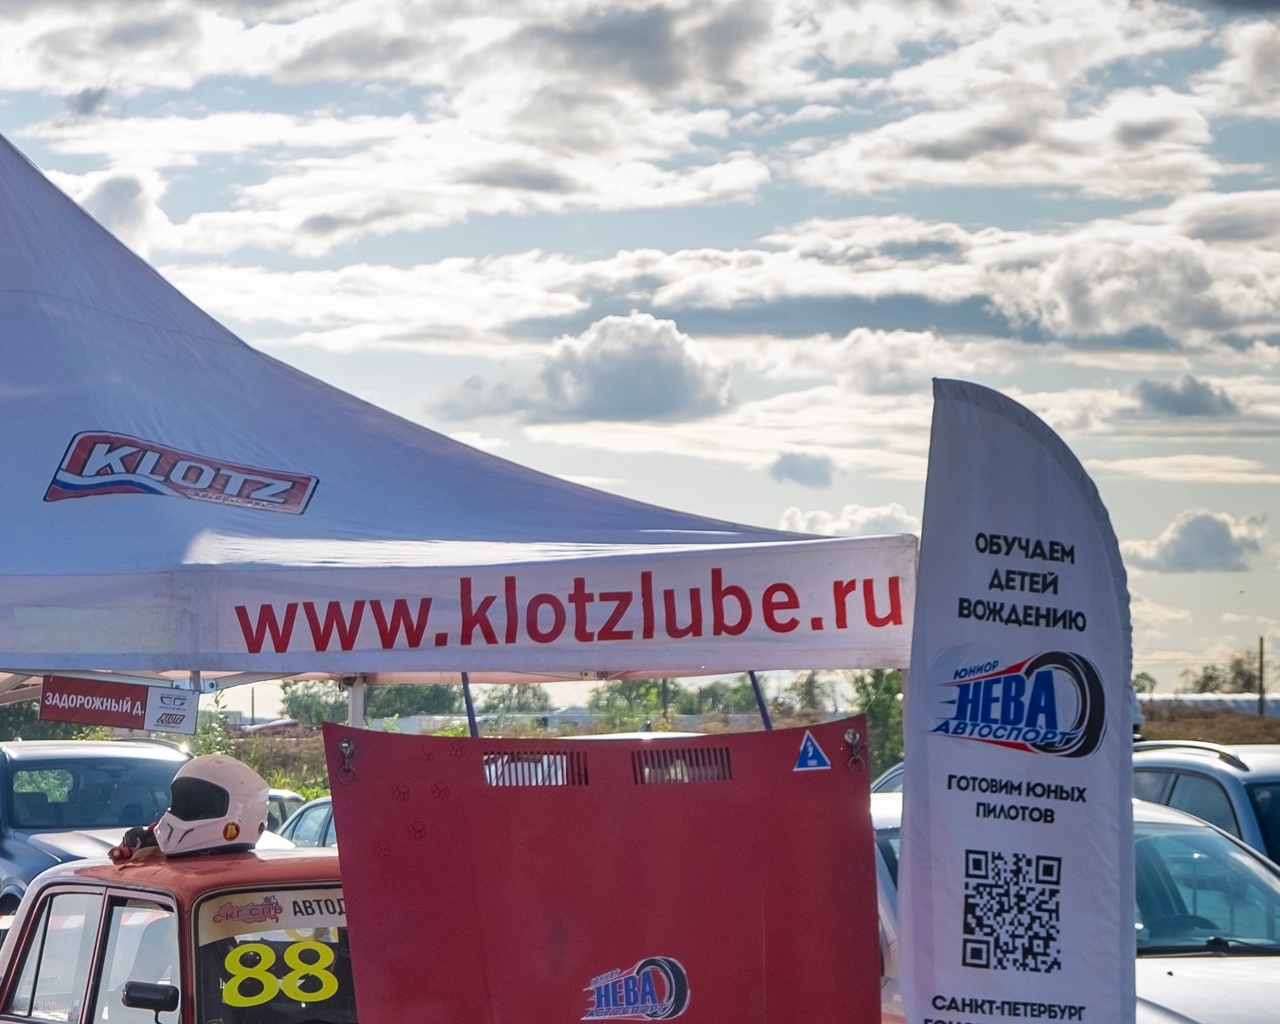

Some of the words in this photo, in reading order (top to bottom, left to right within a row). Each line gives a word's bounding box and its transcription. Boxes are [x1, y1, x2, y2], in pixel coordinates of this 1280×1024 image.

[82, 441, 296, 503] KLOTZ
[975, 532, 1075, 564] ОБУЧАЕМ
[988, 568, 1059, 596] ДЕТЕЙ
[234, 567, 904, 654] www.klotzlube.ru
[957, 597, 1087, 632] ВОЖДЕНИЮ
[953, 660, 999, 680] ЮНИОР
[45, 692, 132, 714] ЗАДОРОЖНЫЙ
[132, 704, 145, 717] Д.
[952, 669, 1058, 731] НЕВА
[931, 719, 1077, 746] АВТОСПОРТ
[947, 774, 1023, 797] ГОТОВИМ
[1025, 780, 1087, 803] ЮНЫХ
[976, 801, 1055, 824] ПИЛОТОВ
[222, 941, 339, 1008] 88
[595, 969, 658, 1009] НЕВА
[586, 1004, 667, 1018] АВТОСПОРТ
[931, 994, 1087, 1021] САНКТ-ПЕТЕРБУРГ
